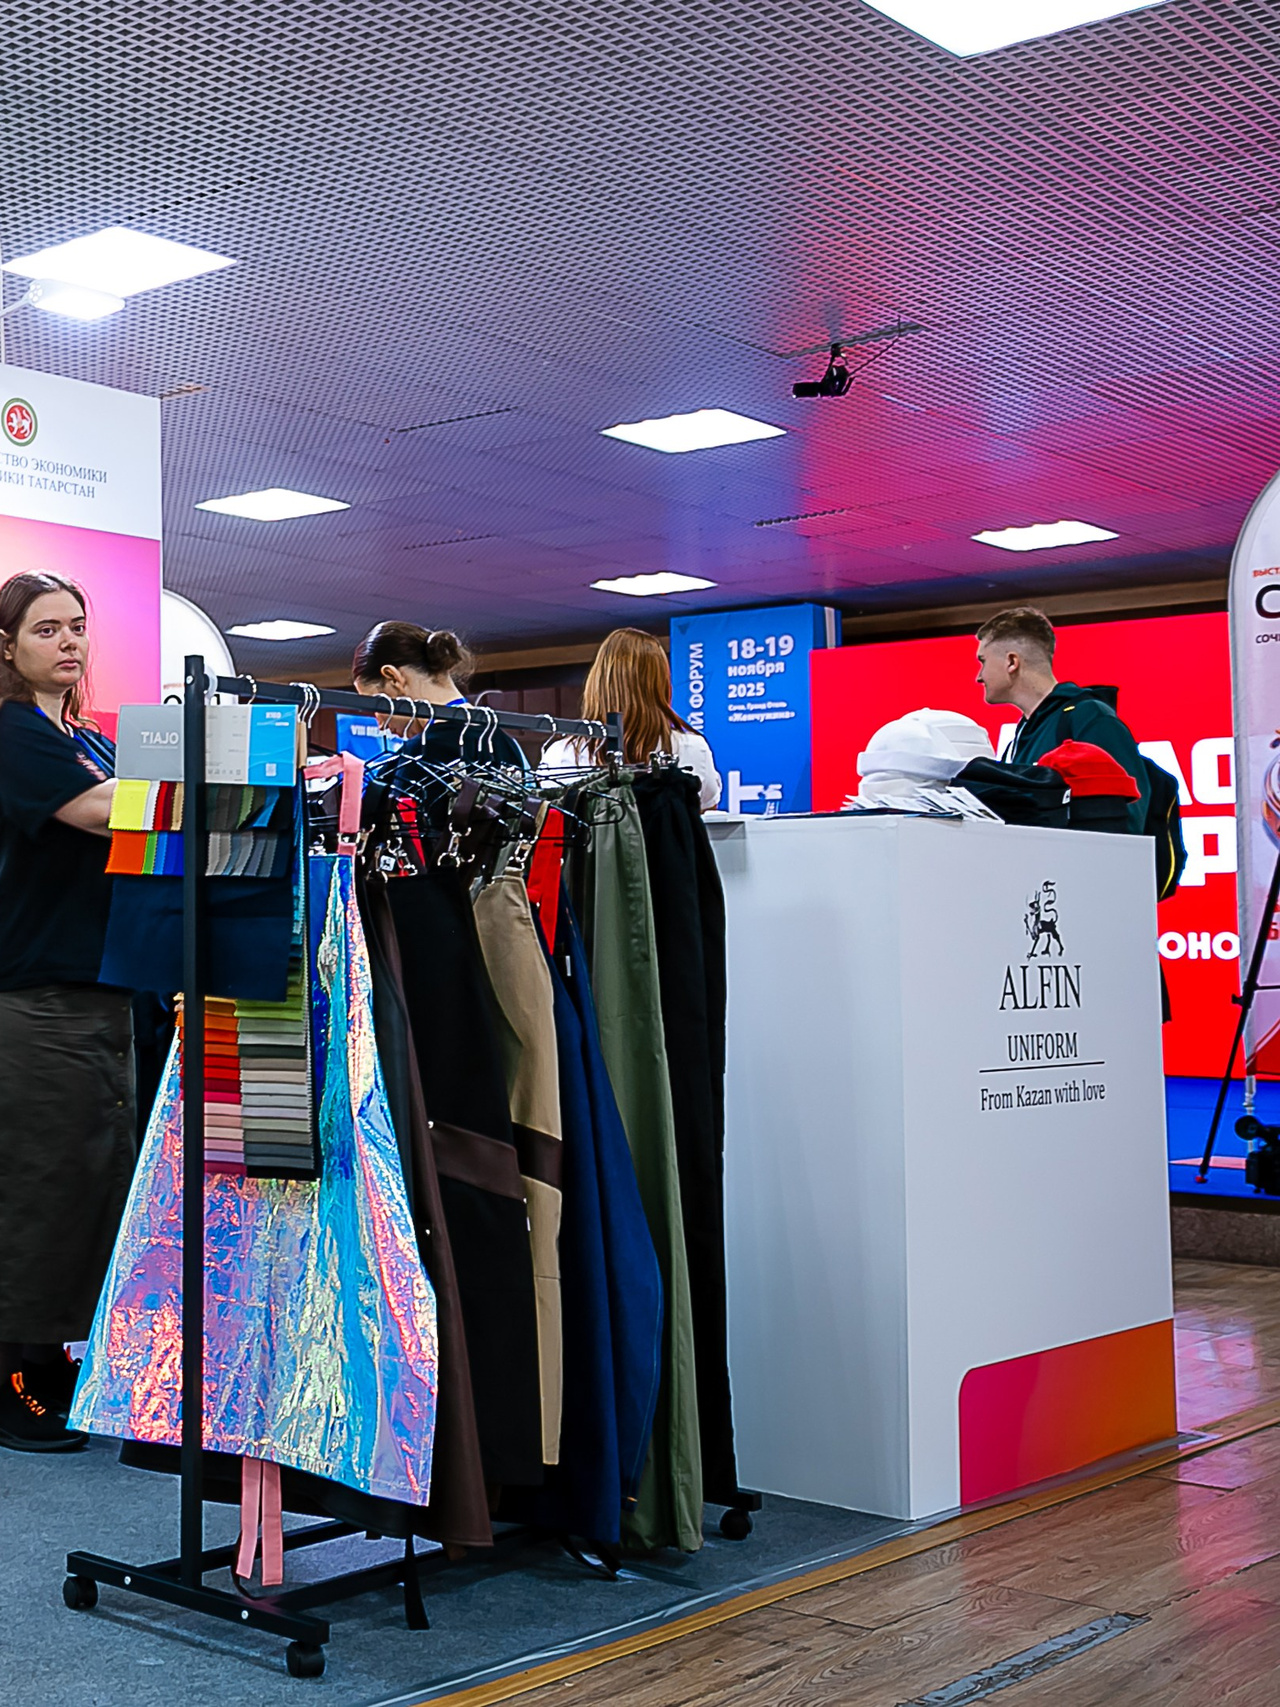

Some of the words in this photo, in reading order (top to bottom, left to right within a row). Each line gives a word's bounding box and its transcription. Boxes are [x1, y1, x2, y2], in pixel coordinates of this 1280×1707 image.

[31, 457, 107, 484] ЭКОНОМИКИ
[27, 475, 96, 499] ТАТАРСТАН
[728, 635, 794, 660] 18-19
[688, 642, 705, 709] ФОРУМ
[728, 661, 785, 677] ноября
[728, 682, 765, 698] 2025
[999, 965, 1081, 1010] ALFIN
[1007, 1032, 1078, 1062] UNIFORM
[981, 1088, 1013, 1111] From
[1016, 1085, 1052, 1108] Kazan
[1054, 1080, 1080, 1104] with
[1082, 1079, 1106, 1101] love
